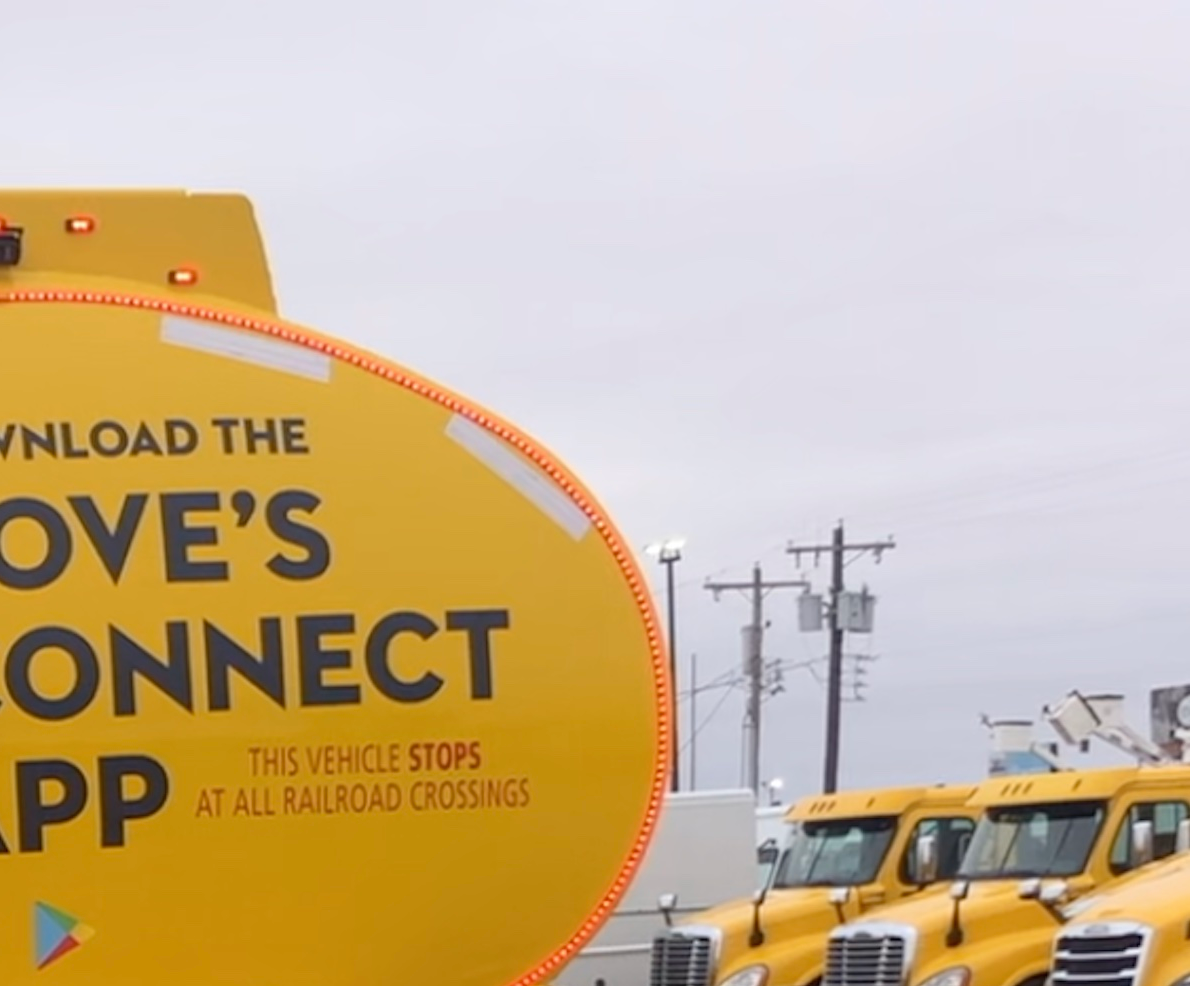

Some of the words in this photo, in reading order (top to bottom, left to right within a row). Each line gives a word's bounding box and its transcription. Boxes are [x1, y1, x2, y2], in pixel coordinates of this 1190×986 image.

[212, 418, 310, 455] THE
[248, 746, 300, 777] THIS
[306, 743, 400, 775] VEHICLE
[409, 741, 482, 772] STOPS
[196, 788, 225, 818] AT
[234, 785, 276, 817] ALL
[284, 783, 403, 816] RAILROAD
[410, 778, 531, 812] CROSSINGS
